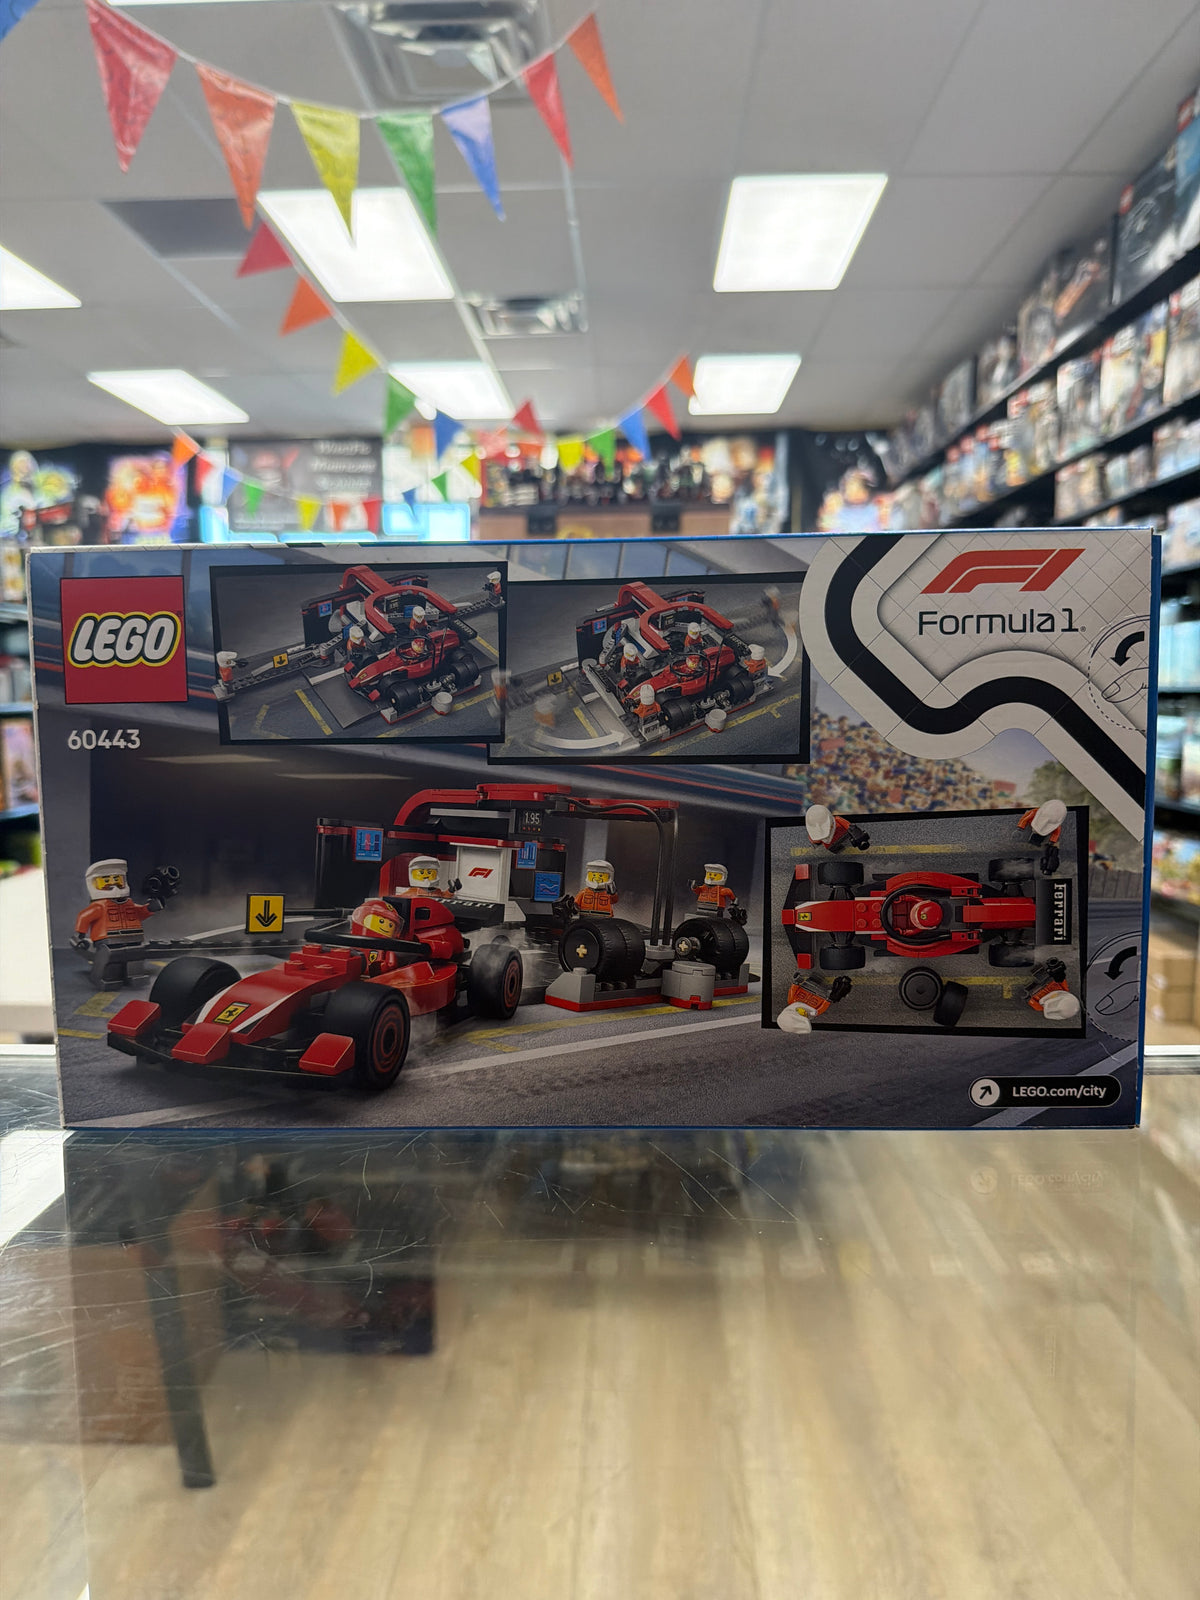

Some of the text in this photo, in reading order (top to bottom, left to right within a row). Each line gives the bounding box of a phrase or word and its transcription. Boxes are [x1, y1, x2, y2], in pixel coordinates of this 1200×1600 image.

[70, 613, 179, 666] LEGO
[67, 729, 141, 750] 60443
[1012, 1085, 1107, 1098] LEGO.com/city
